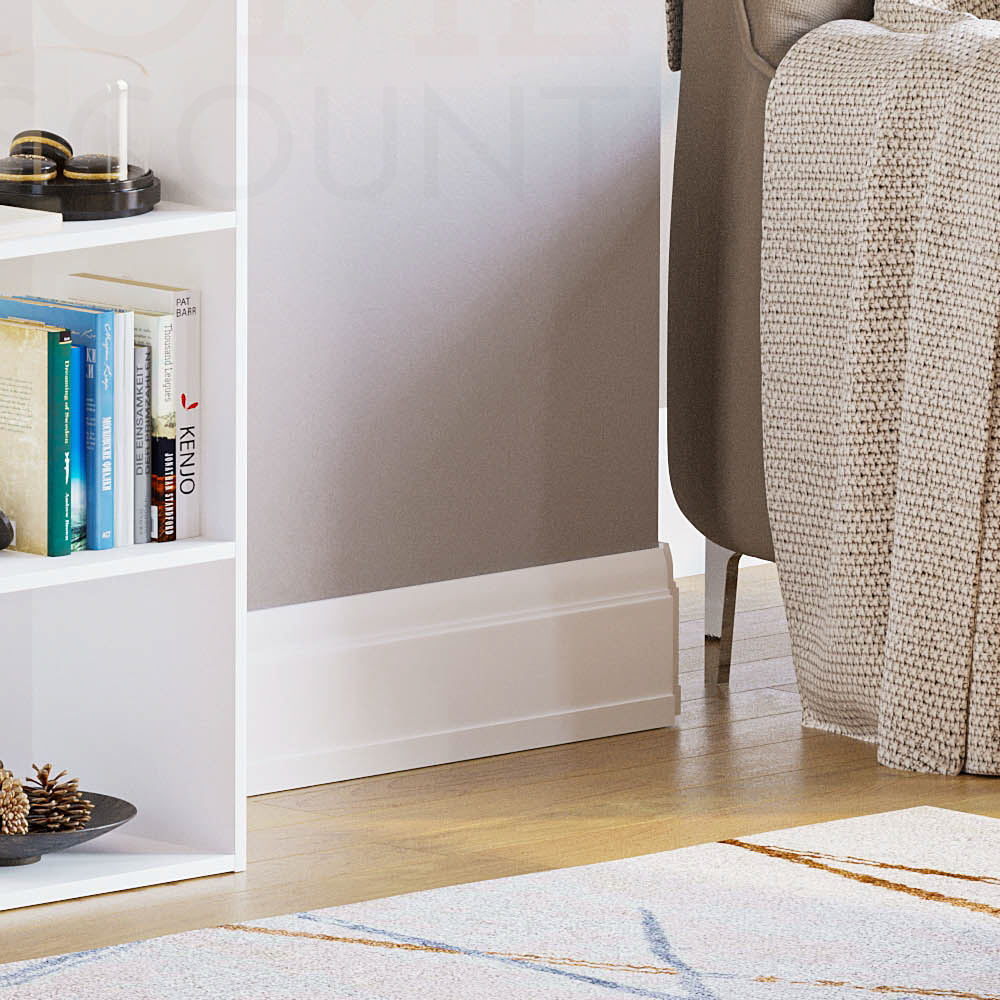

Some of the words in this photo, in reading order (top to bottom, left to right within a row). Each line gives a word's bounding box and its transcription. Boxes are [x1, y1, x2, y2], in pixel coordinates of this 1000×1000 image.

[176, 296, 190, 306] PAT
[176, 306, 196, 317] BARR
[164, 323, 173, 365] Thousand
[163, 367, 173, 402] Leagues
[136, 366, 144, 449] EINSAMKEIT
[136, 454, 144, 475] DIE
[164, 453, 174, 491] JONATHAN
[179, 426, 195, 495] KENJO
[164, 493, 174, 535] STANDFORD
